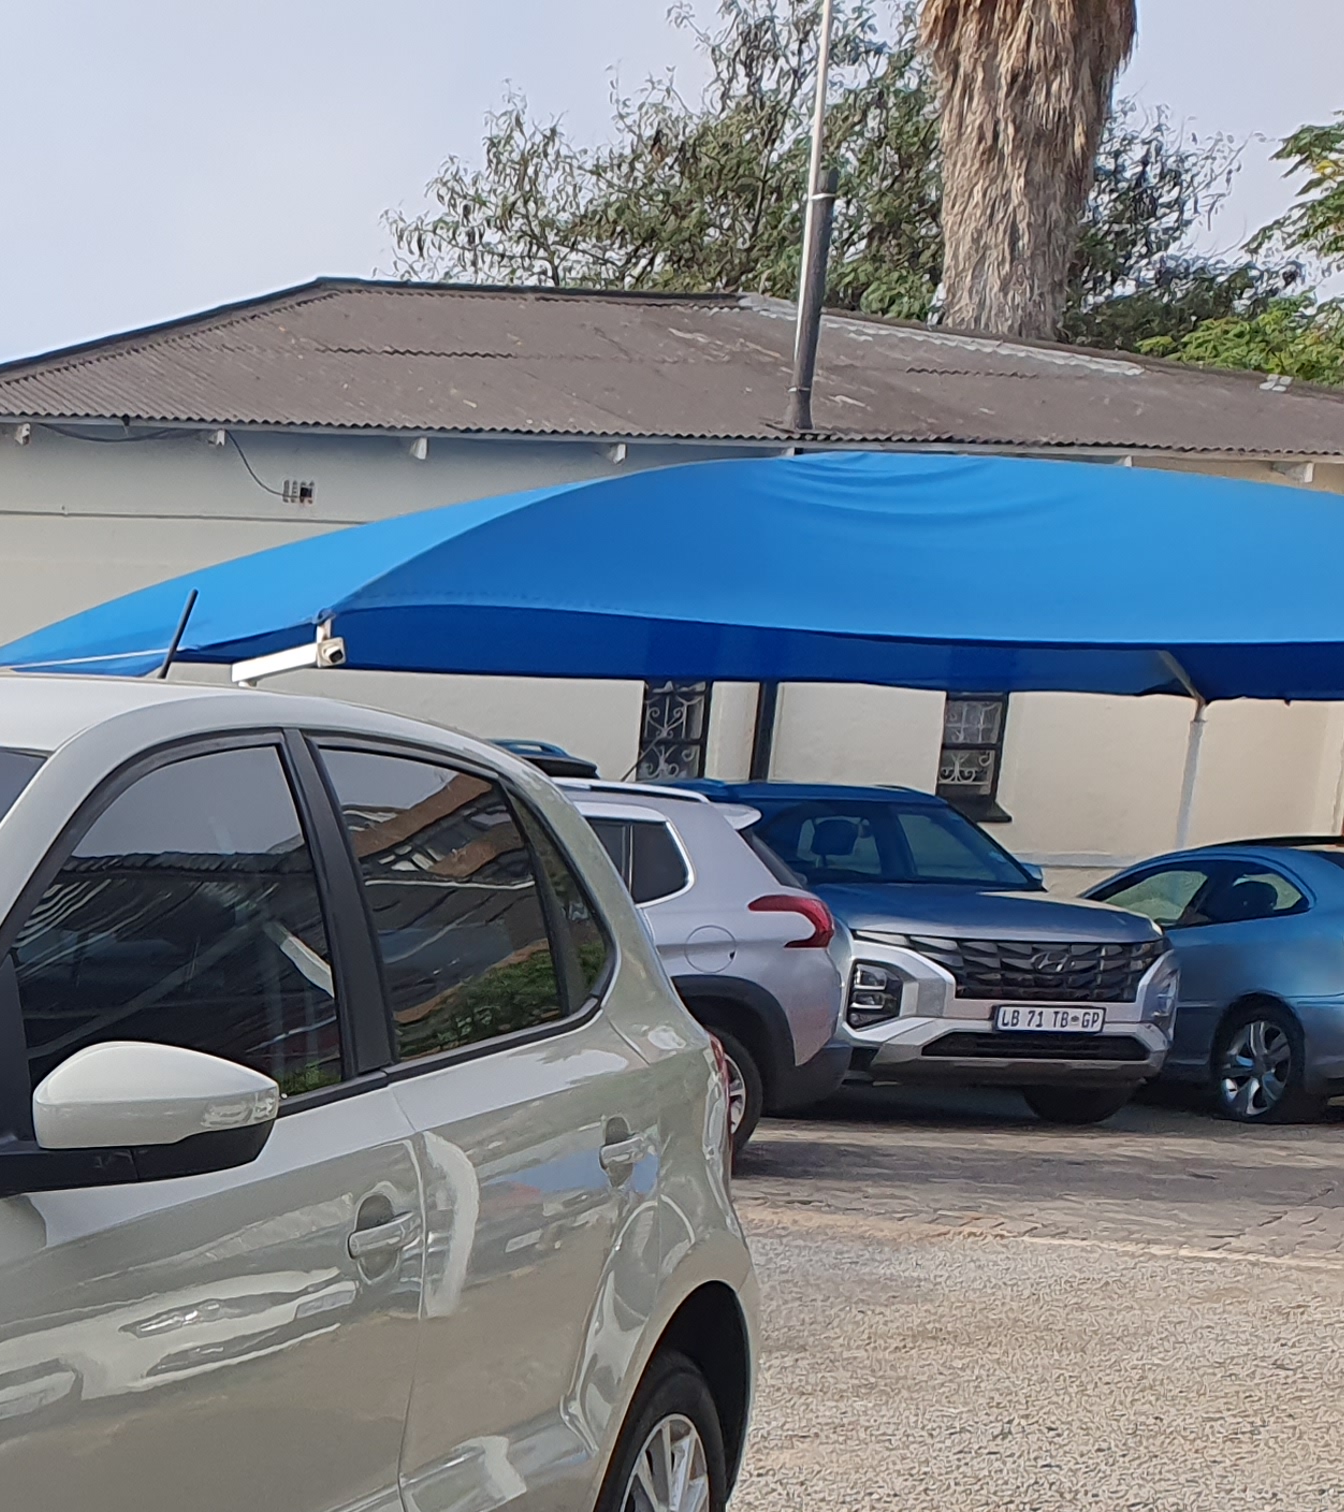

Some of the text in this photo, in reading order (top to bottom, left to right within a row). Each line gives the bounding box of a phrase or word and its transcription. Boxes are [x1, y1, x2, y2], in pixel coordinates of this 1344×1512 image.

[1001, 1010, 1100, 1029] LB 71 TB GP
